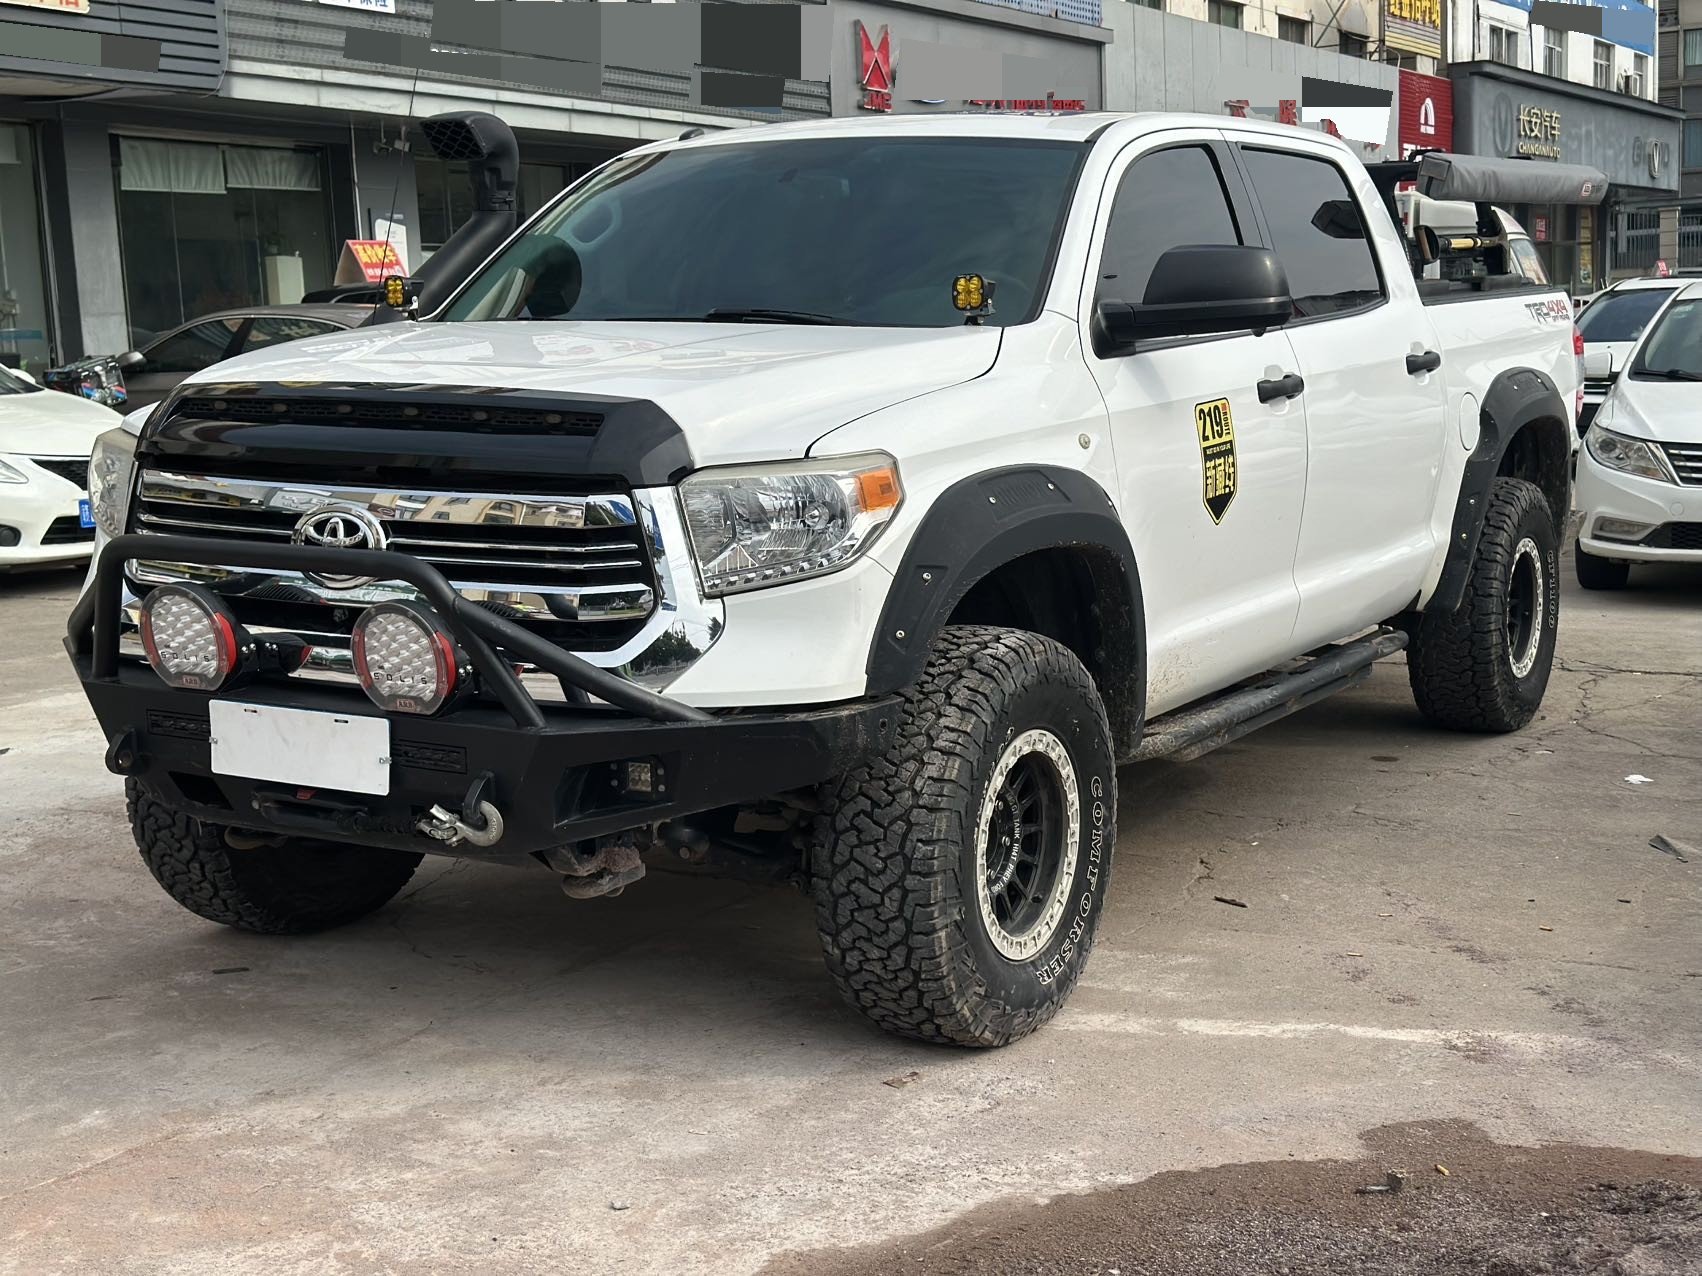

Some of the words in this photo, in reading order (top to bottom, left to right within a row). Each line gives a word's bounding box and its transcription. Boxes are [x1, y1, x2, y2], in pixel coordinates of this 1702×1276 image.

[1519, 103, 1561, 141] 长安汽车
[1524, 302, 1551, 325] TRD
[1199, 405, 1223, 442] 219
[1222, 411, 1231, 436] ROUTE
[161, 651, 210, 662] SOLIS
[373, 672, 428, 684] SOLIS
[1013, 818, 1021, 839] TANK
[1001, 863, 1015, 883] PHEV
[1036, 775, 1104, 985] COMFORSER
